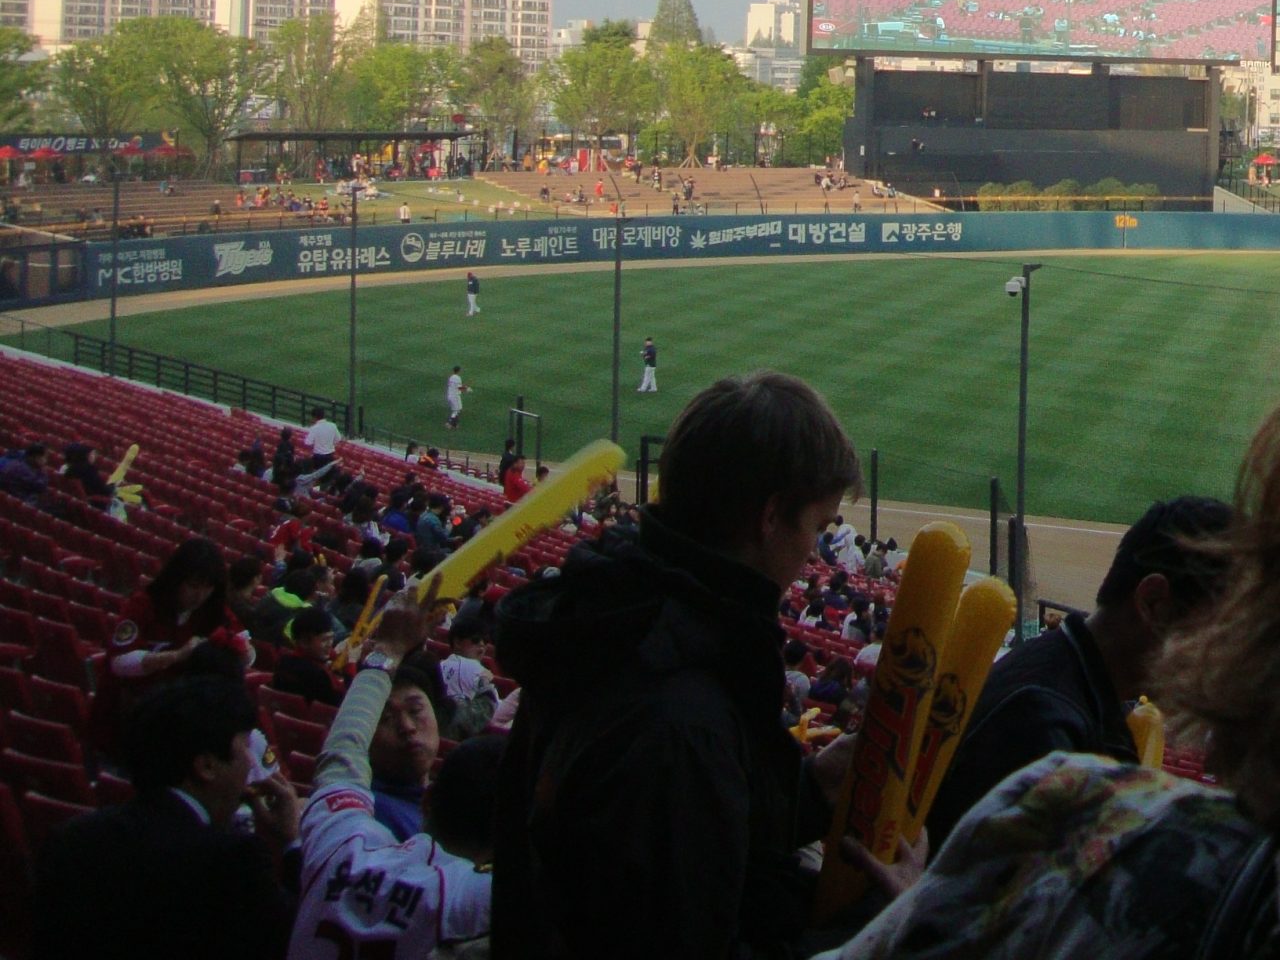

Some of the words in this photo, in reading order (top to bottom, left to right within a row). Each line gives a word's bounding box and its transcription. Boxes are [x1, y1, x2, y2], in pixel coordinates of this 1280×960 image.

[1240, 59, 1272, 68] SAMIK
[788, 222, 866, 244] 대방건설
[901, 222, 963, 241] 광주은행
[425, 239, 487, 261] 블루나래
[500, 235, 580, 258] 노루페인트
[214, 241, 274, 277] Tigers
